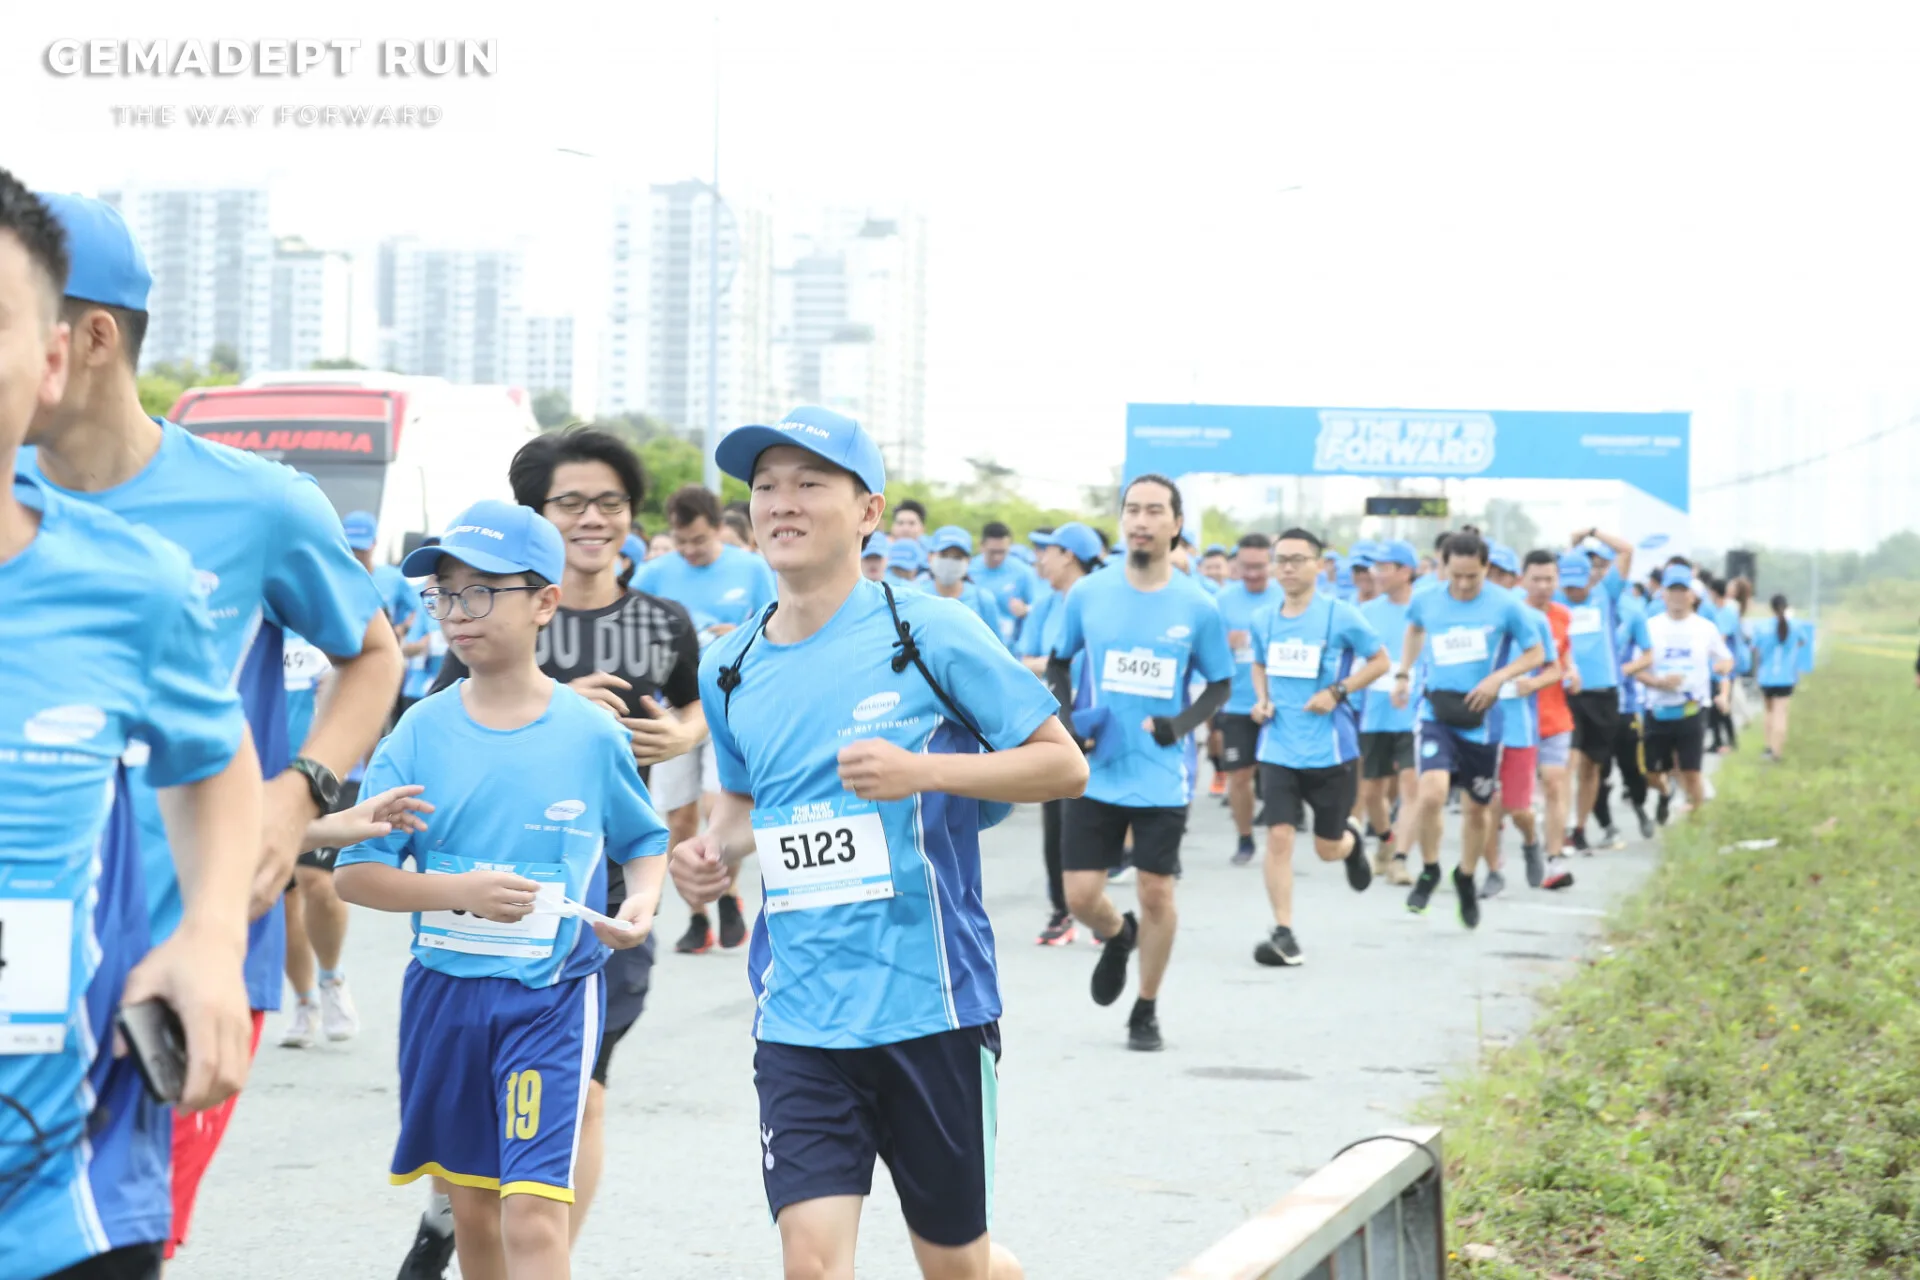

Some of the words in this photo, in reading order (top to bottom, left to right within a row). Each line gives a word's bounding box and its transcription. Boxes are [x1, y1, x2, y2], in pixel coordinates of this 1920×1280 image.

[805, 425, 830, 439] RUN
[1117, 656, 1162, 678] 5495
[836, 728, 852, 737] THE
[854, 724, 873, 735] WAY
[875, 716, 920, 731] FORWARD
[780, 828, 857, 870] 5123
[506, 1069, 543, 1140] 19
